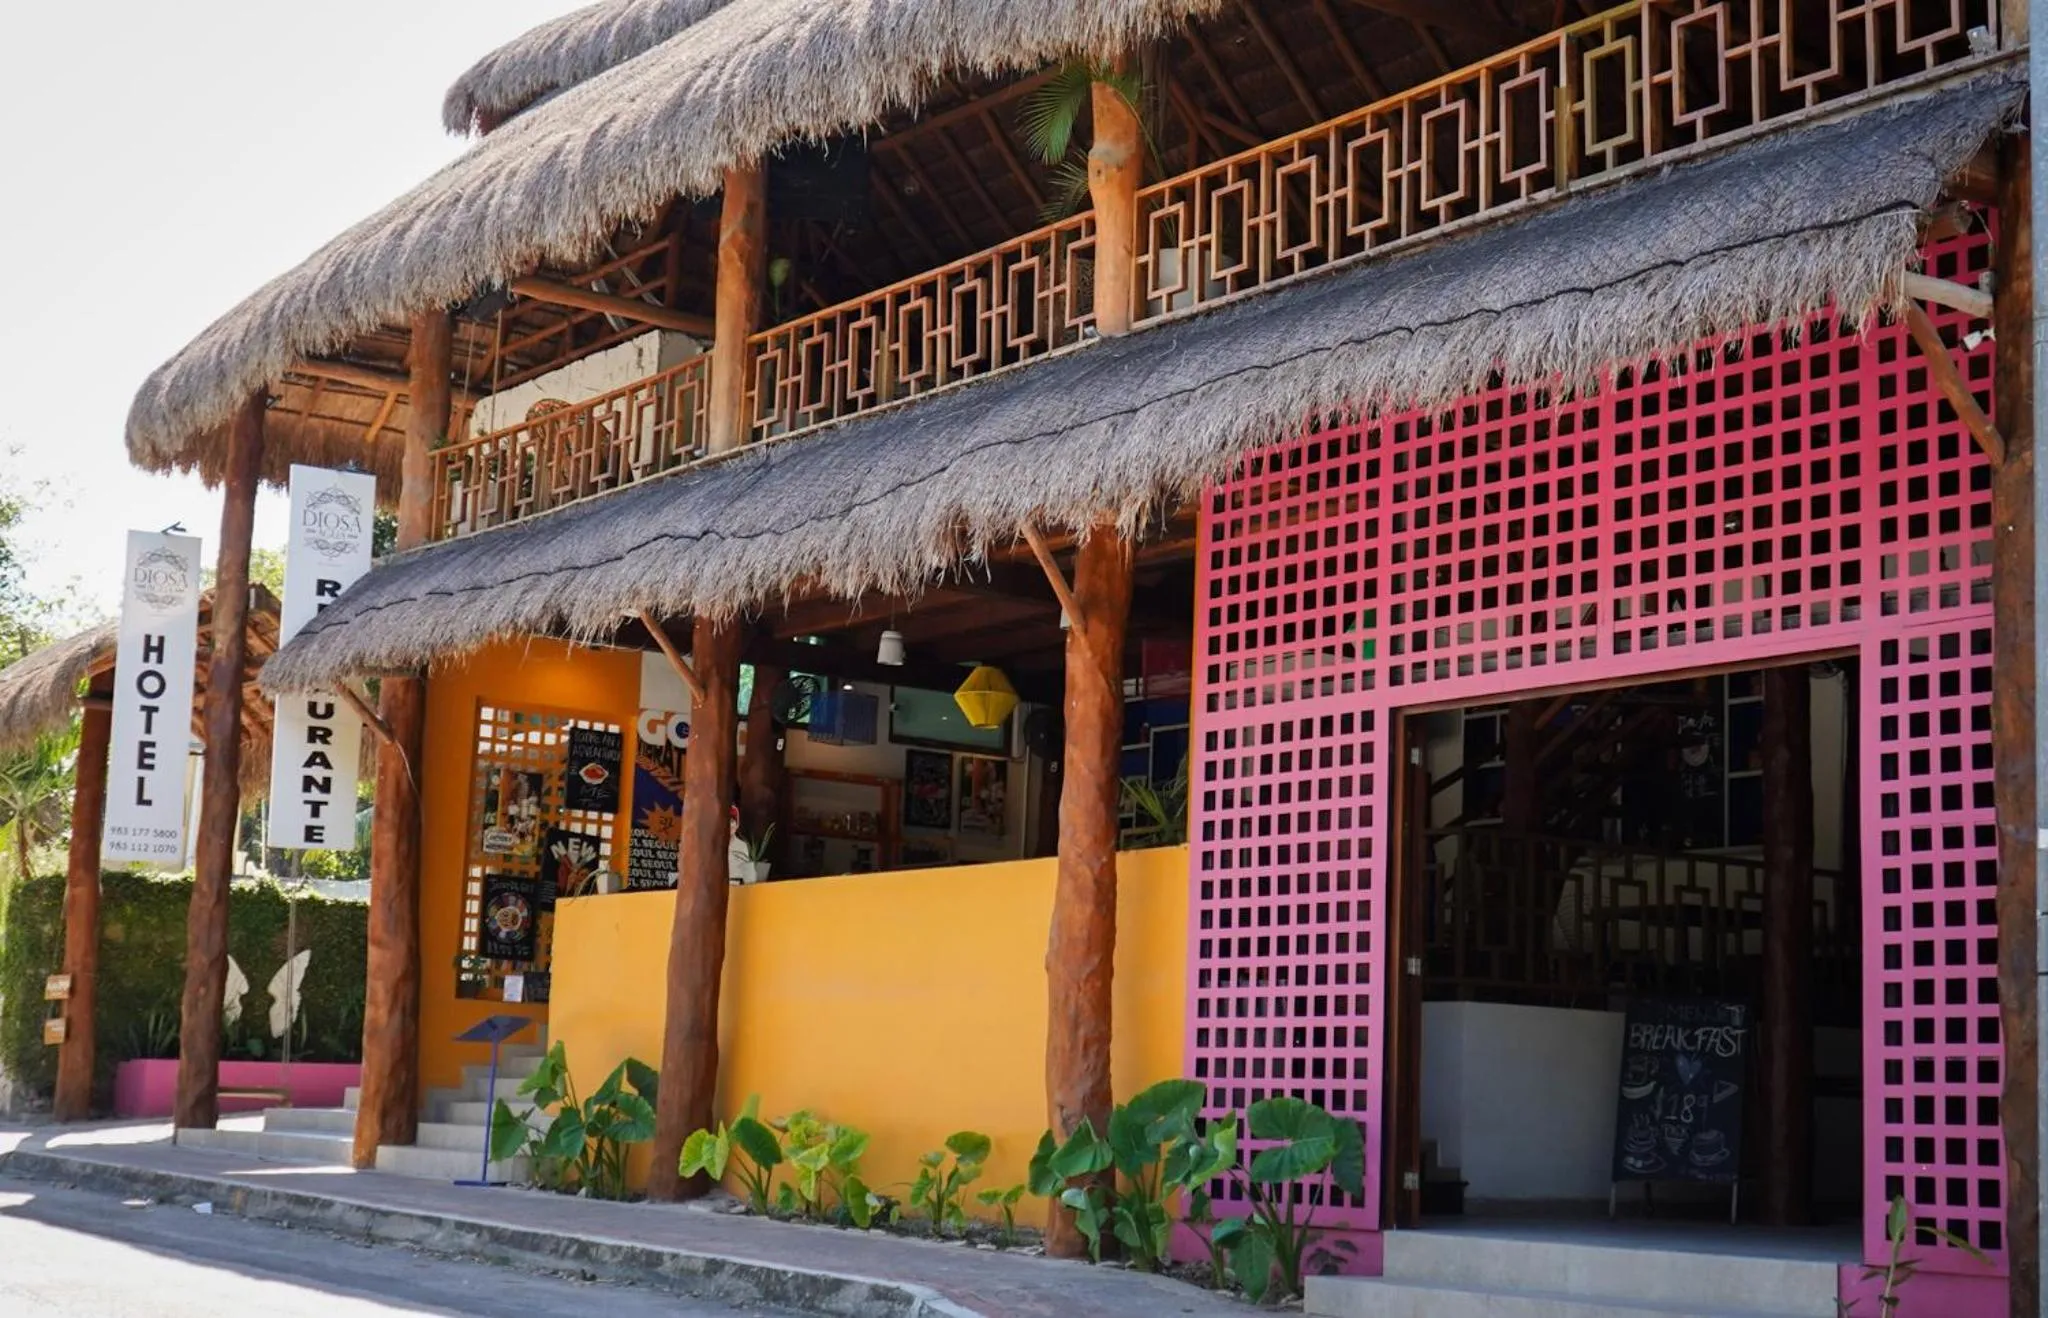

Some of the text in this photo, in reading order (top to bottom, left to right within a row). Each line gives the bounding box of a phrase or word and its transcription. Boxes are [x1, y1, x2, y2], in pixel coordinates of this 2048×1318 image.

[302, 509, 361, 532] DIOSA
[133, 567, 188, 589] DIOSA
[136, 633, 166, 807] HOTEL
[131, 842, 149, 852] 112
[549, 837, 597, 862] NEW
[1629, 1023, 1748, 1057] BREAKFAST
